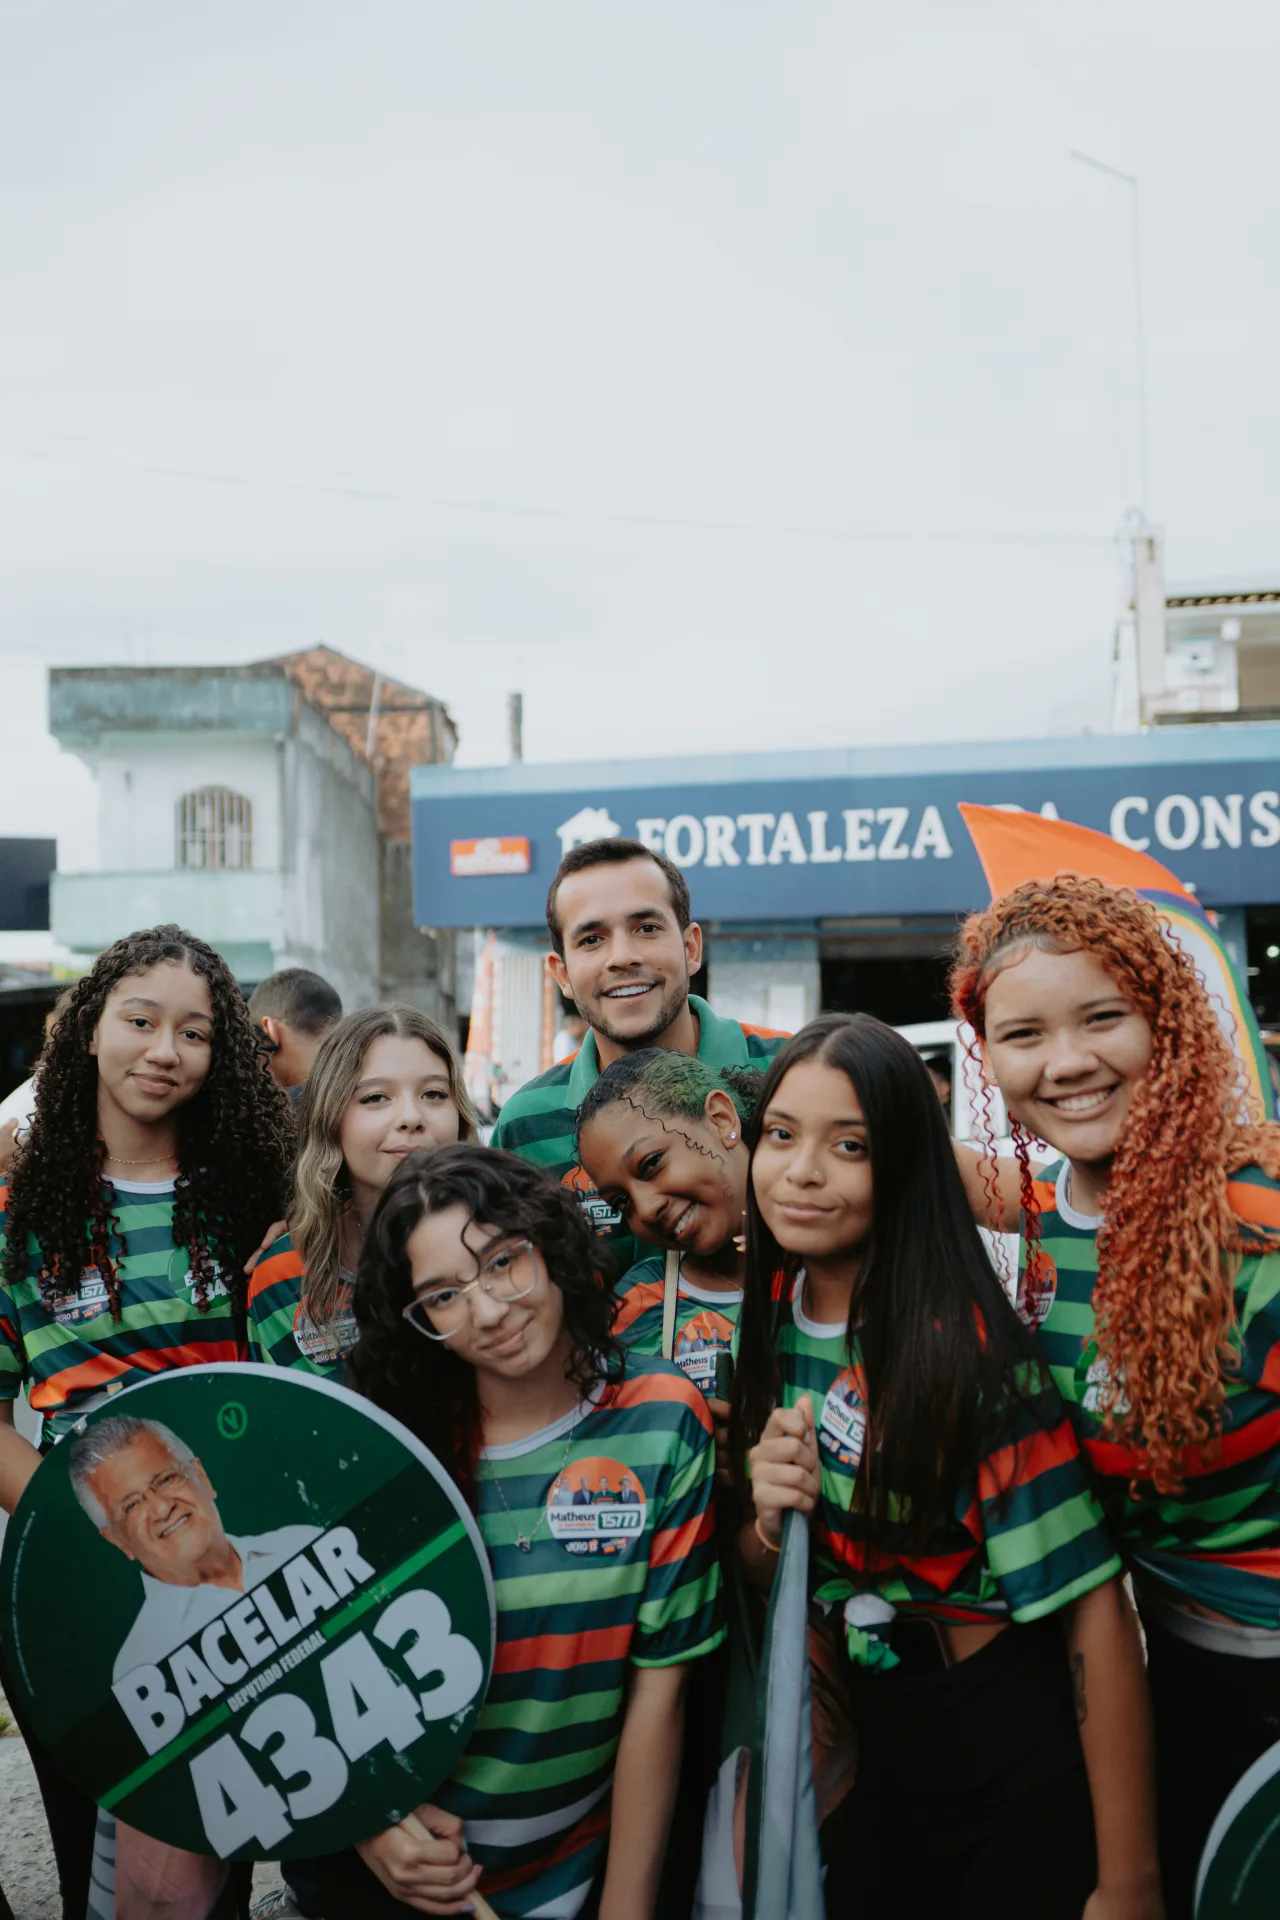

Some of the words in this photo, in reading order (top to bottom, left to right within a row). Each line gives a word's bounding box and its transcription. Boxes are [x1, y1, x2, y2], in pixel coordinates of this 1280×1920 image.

[636, 805, 953, 867] FORTALEZA
[1109, 791, 1280, 850] CONS
[551, 1510, 596, 1523] Matheus
[112, 1525, 376, 1756] BACELAR
[227, 1662, 283, 1713] DEPUTADO
[279, 1629, 327, 1673] FEDERAL
[188, 1588, 484, 1860] 4343
